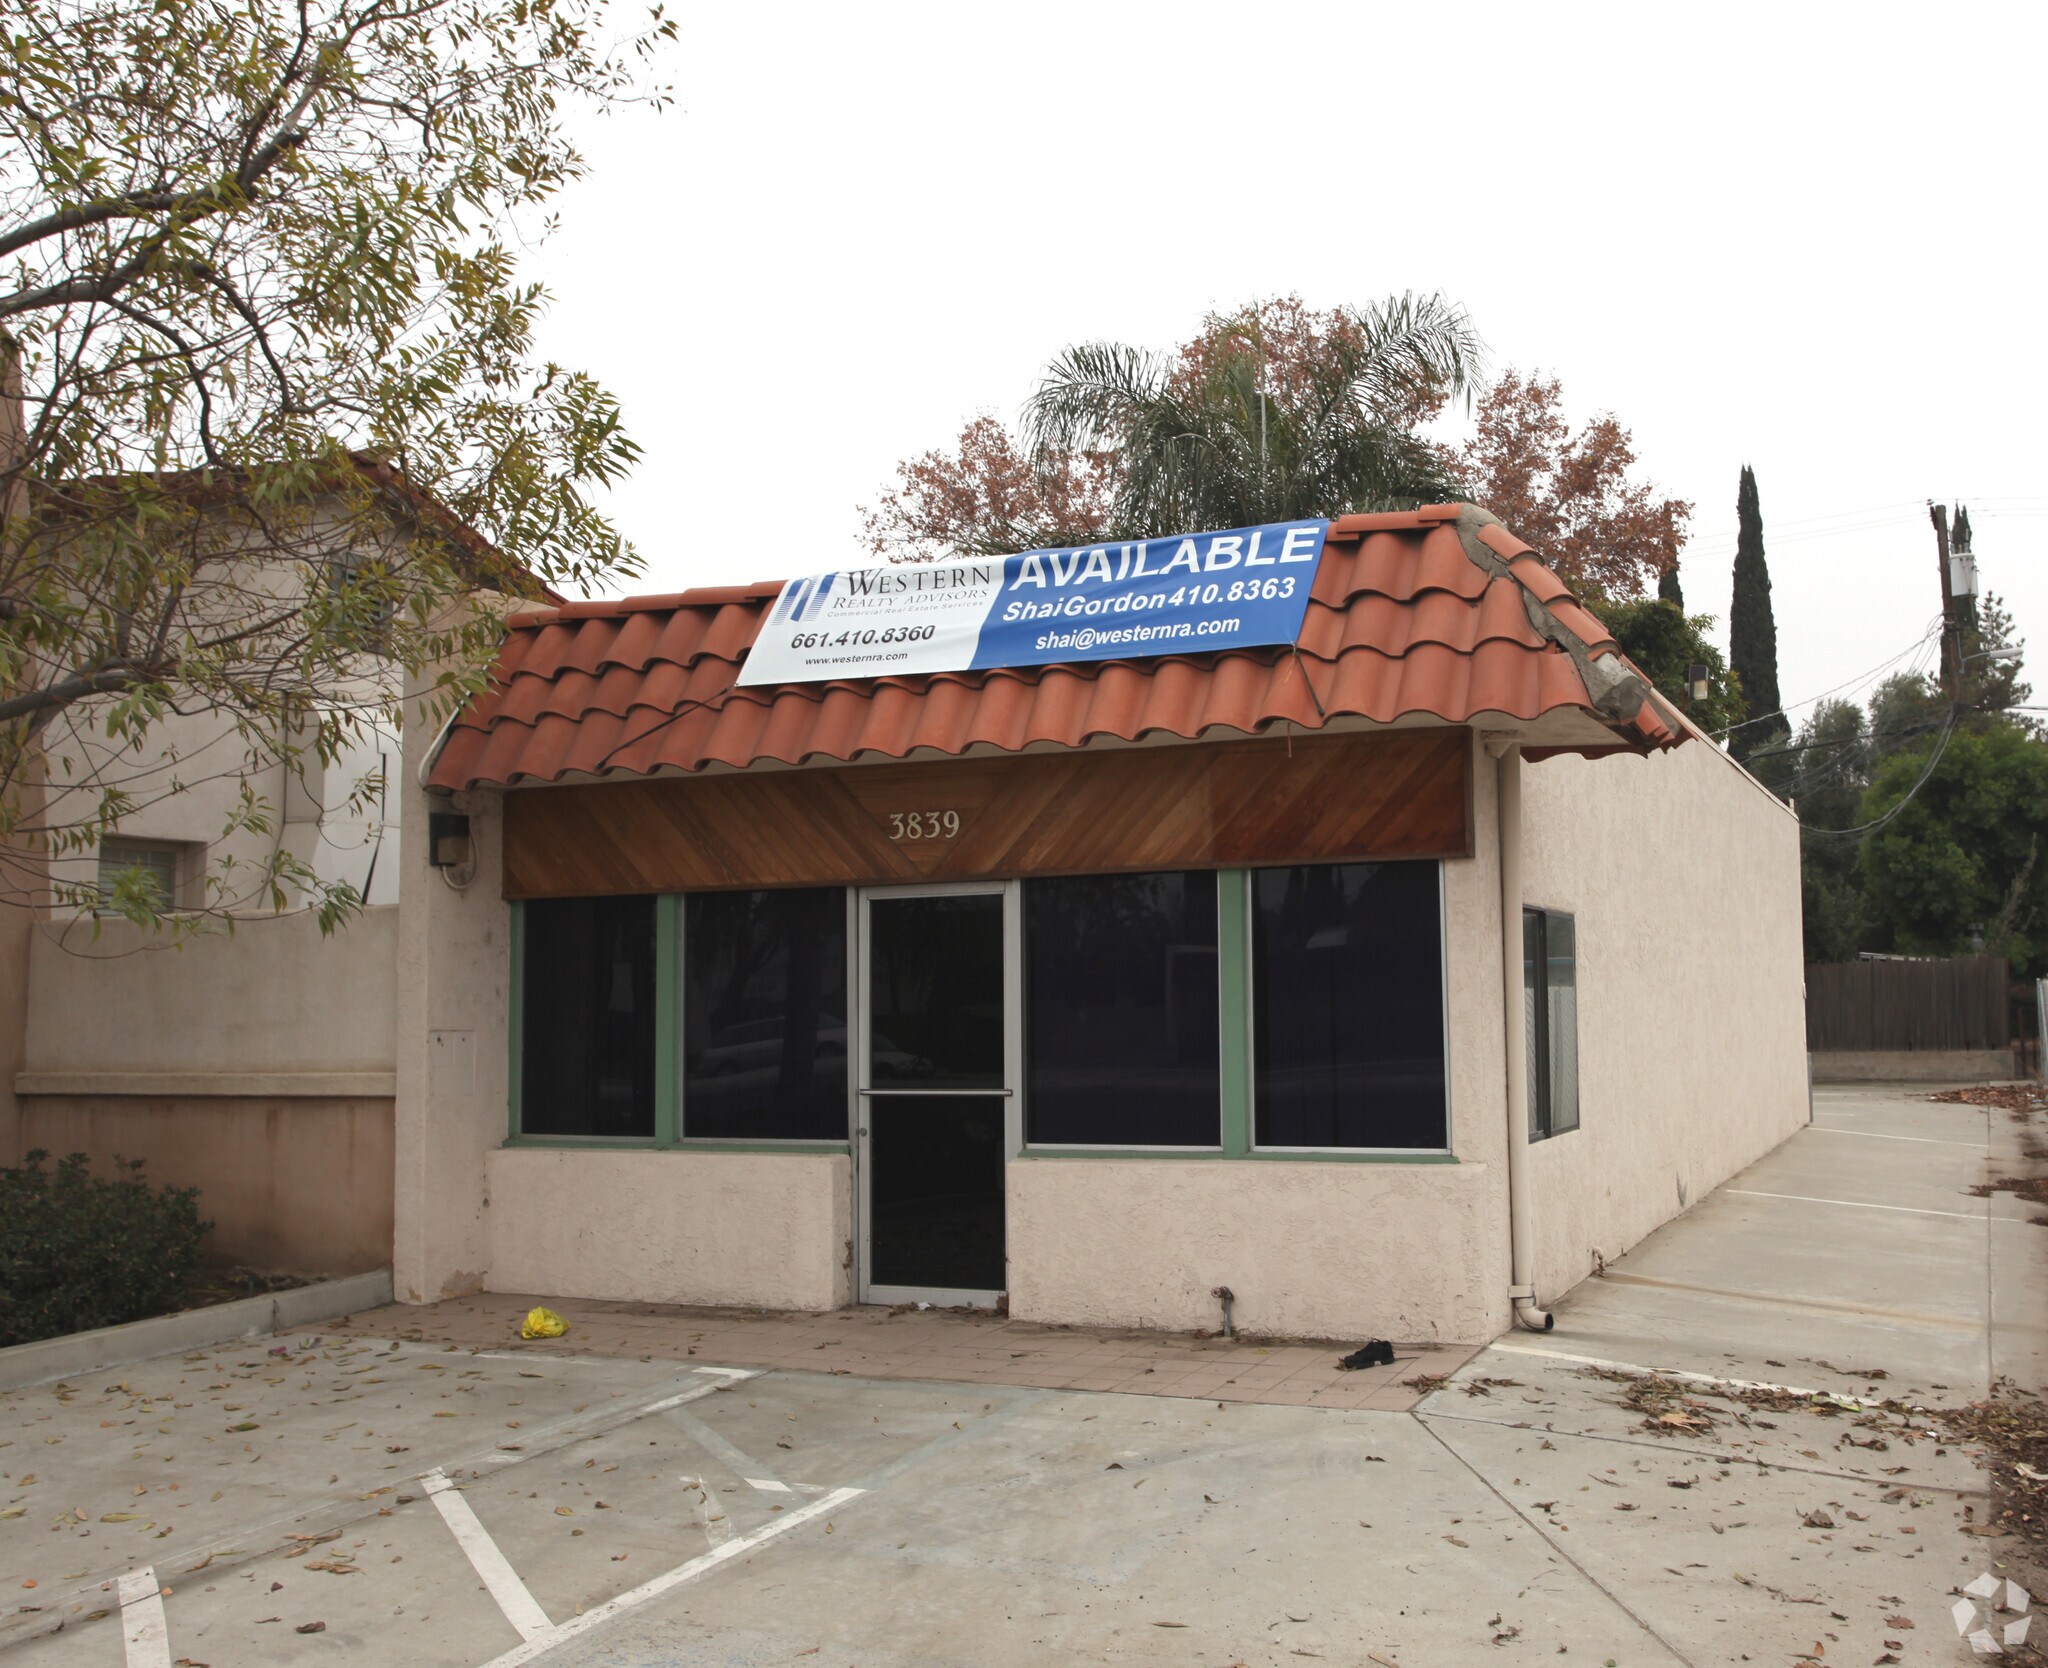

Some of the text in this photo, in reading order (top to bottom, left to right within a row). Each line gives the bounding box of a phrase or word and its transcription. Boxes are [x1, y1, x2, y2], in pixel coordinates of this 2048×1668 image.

[1008, 527, 1320, 591] AVAILABLE
[848, 565, 992, 596] WESTERN
[1168, 577, 1296, 605] 410.8363
[827, 601, 984, 617] Commercial Real Estate Services
[903, 588, 989, 604] ADVISORS
[791, 624, 936, 650] 661.410.8360
[1035, 618, 1240, 650] shai@westernra.com
[805, 651, 908, 665] www.westernra.com
[888, 810, 960, 840] 3839
